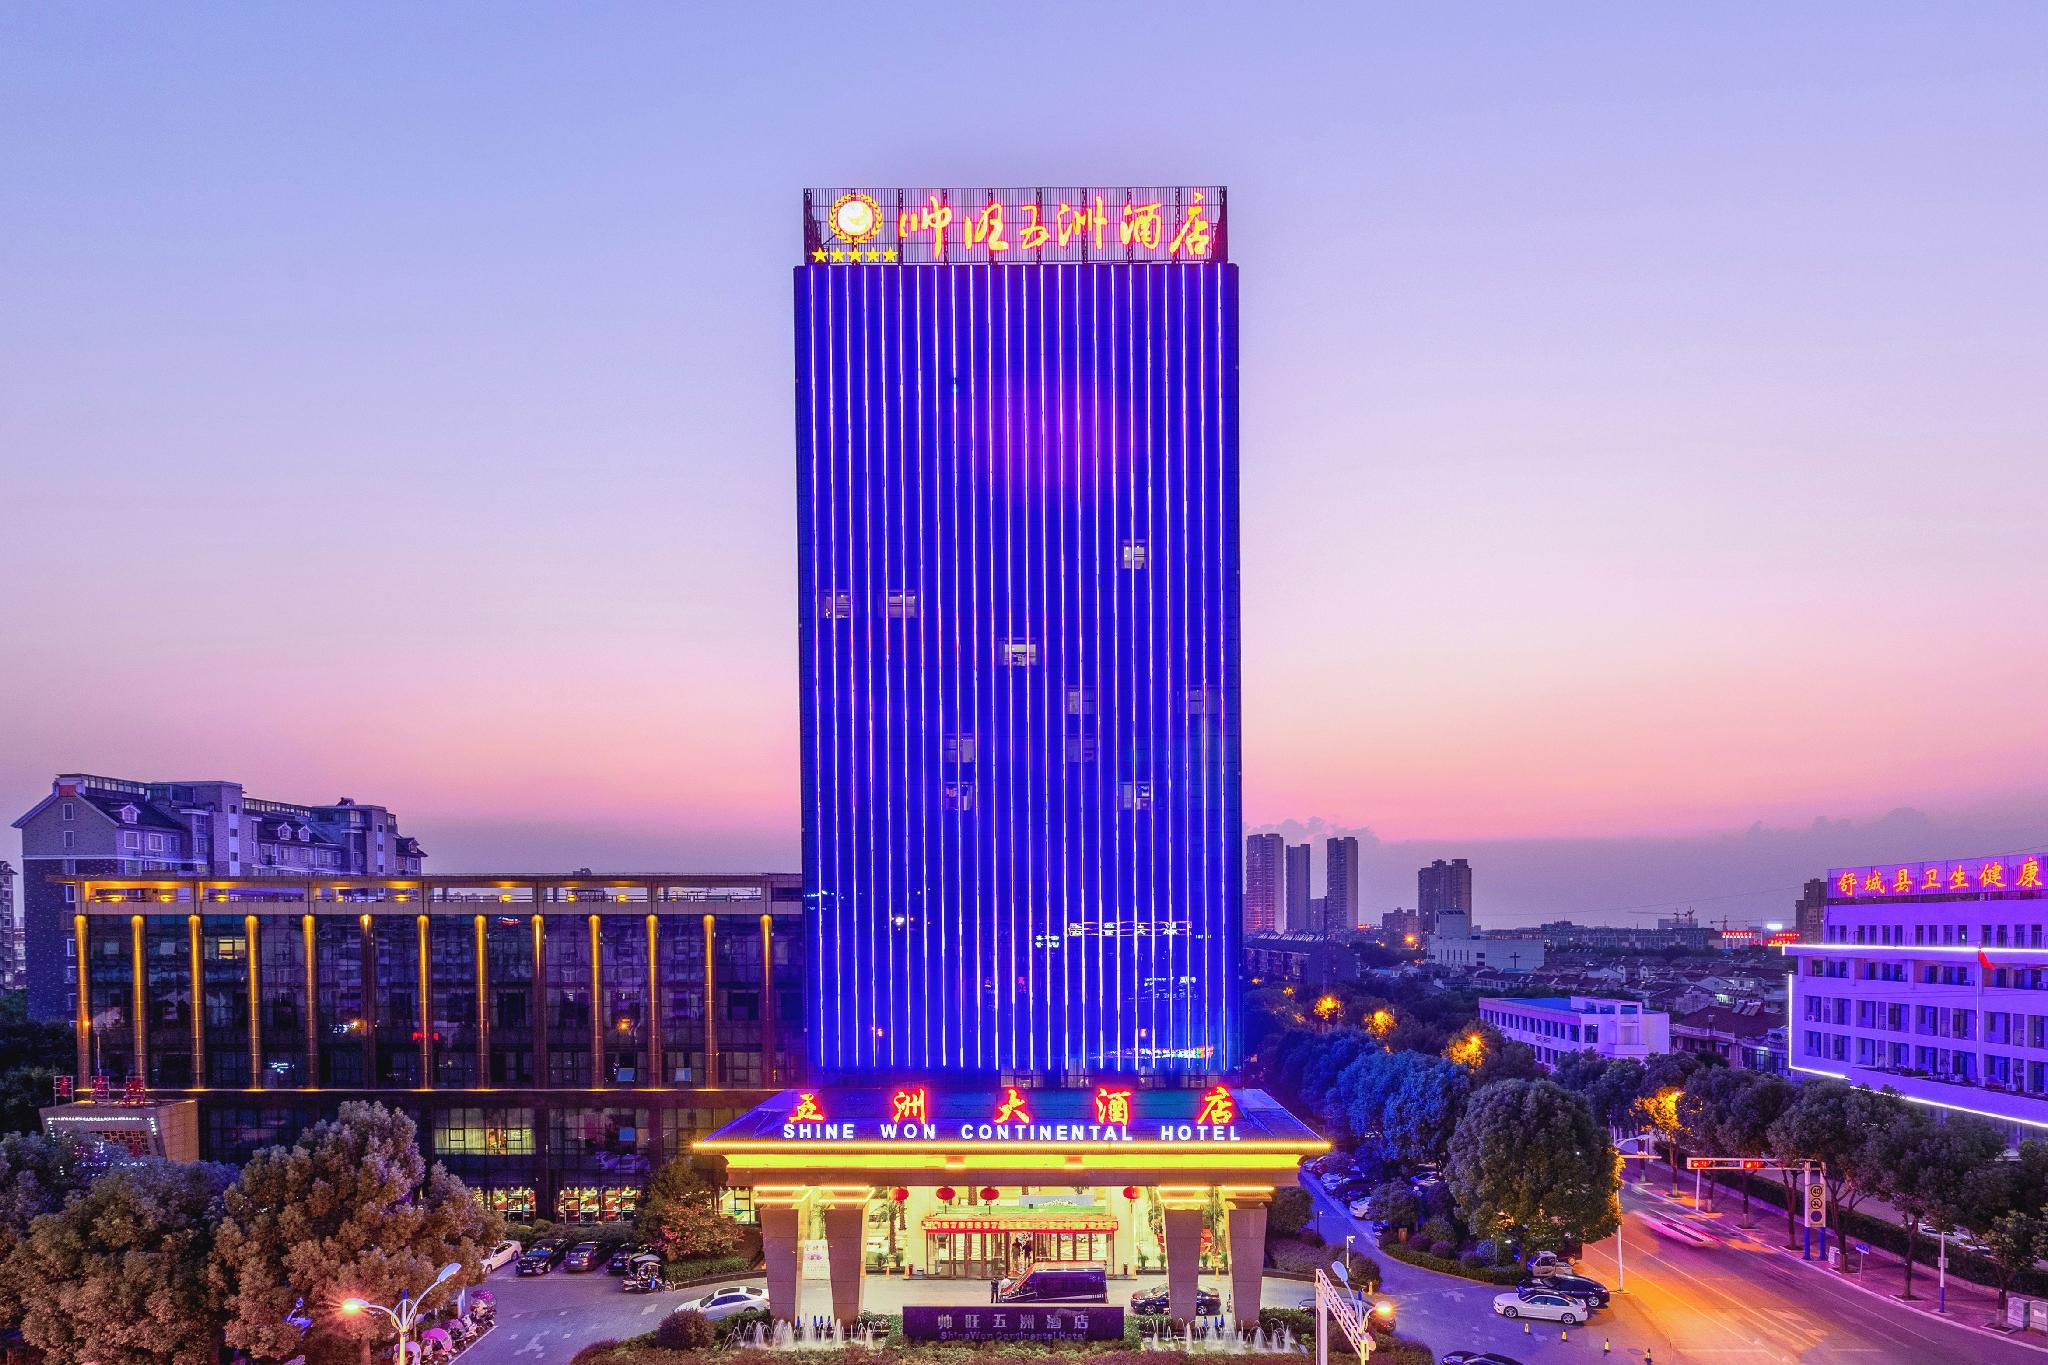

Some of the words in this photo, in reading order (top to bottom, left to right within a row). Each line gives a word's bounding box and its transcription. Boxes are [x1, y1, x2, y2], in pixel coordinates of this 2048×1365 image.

[1838, 856, 2043, 896] 舒城县卫生健康
[788, 1087, 1233, 1125] 五洲大酒店
[783, 1123, 855, 1139] SHINE
[880, 1124, 936, 1140] WON
[961, 1124, 1133, 1141] CONTINENTAL
[1161, 1125, 1241, 1141] HOTEL
[937, 1313, 1090, 1330] 帅旺五洲酒店
